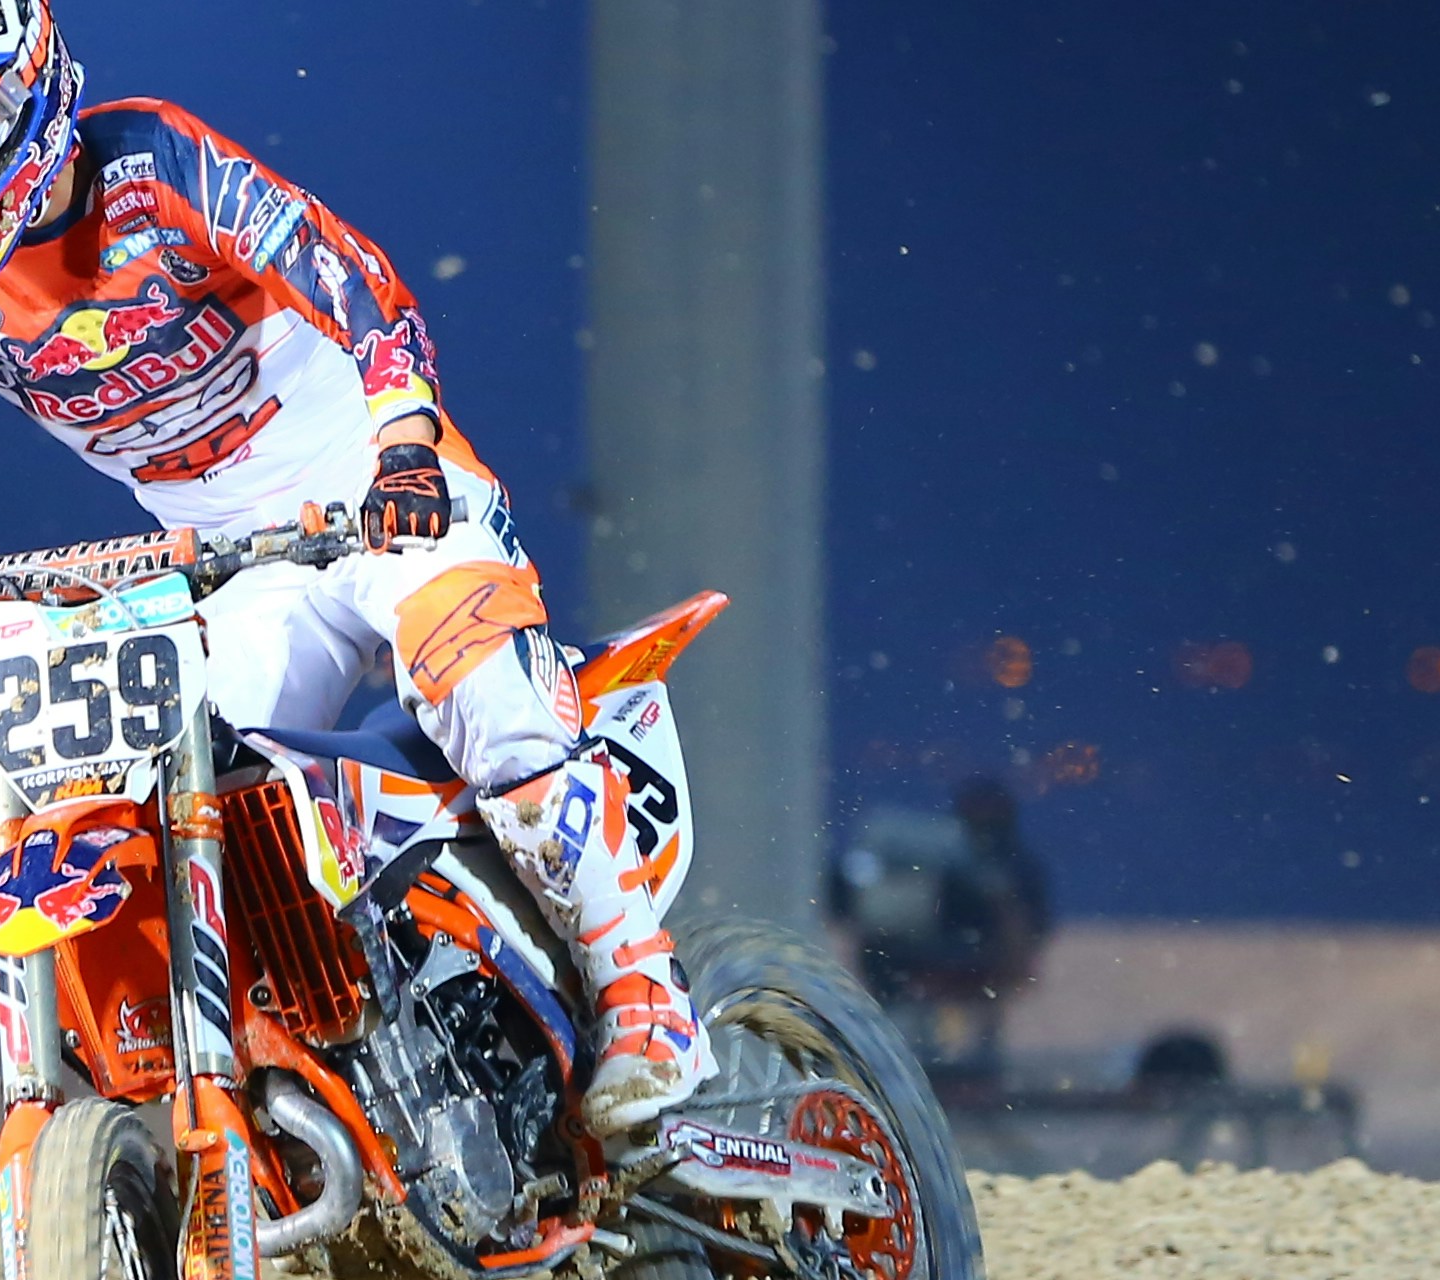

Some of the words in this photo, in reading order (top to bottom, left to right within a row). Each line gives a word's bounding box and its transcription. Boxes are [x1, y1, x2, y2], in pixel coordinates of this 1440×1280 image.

[24, 372, 142, 421] Red
[121, 304, 236, 393] Bull
[629, 700, 661, 742] MXGP
[21, 765, 95, 791] SCORPION
[52, 777, 104, 801] KTM
[202, 1167, 233, 1271] ATHENA
[227, 1146, 256, 1280] MOTOREX
